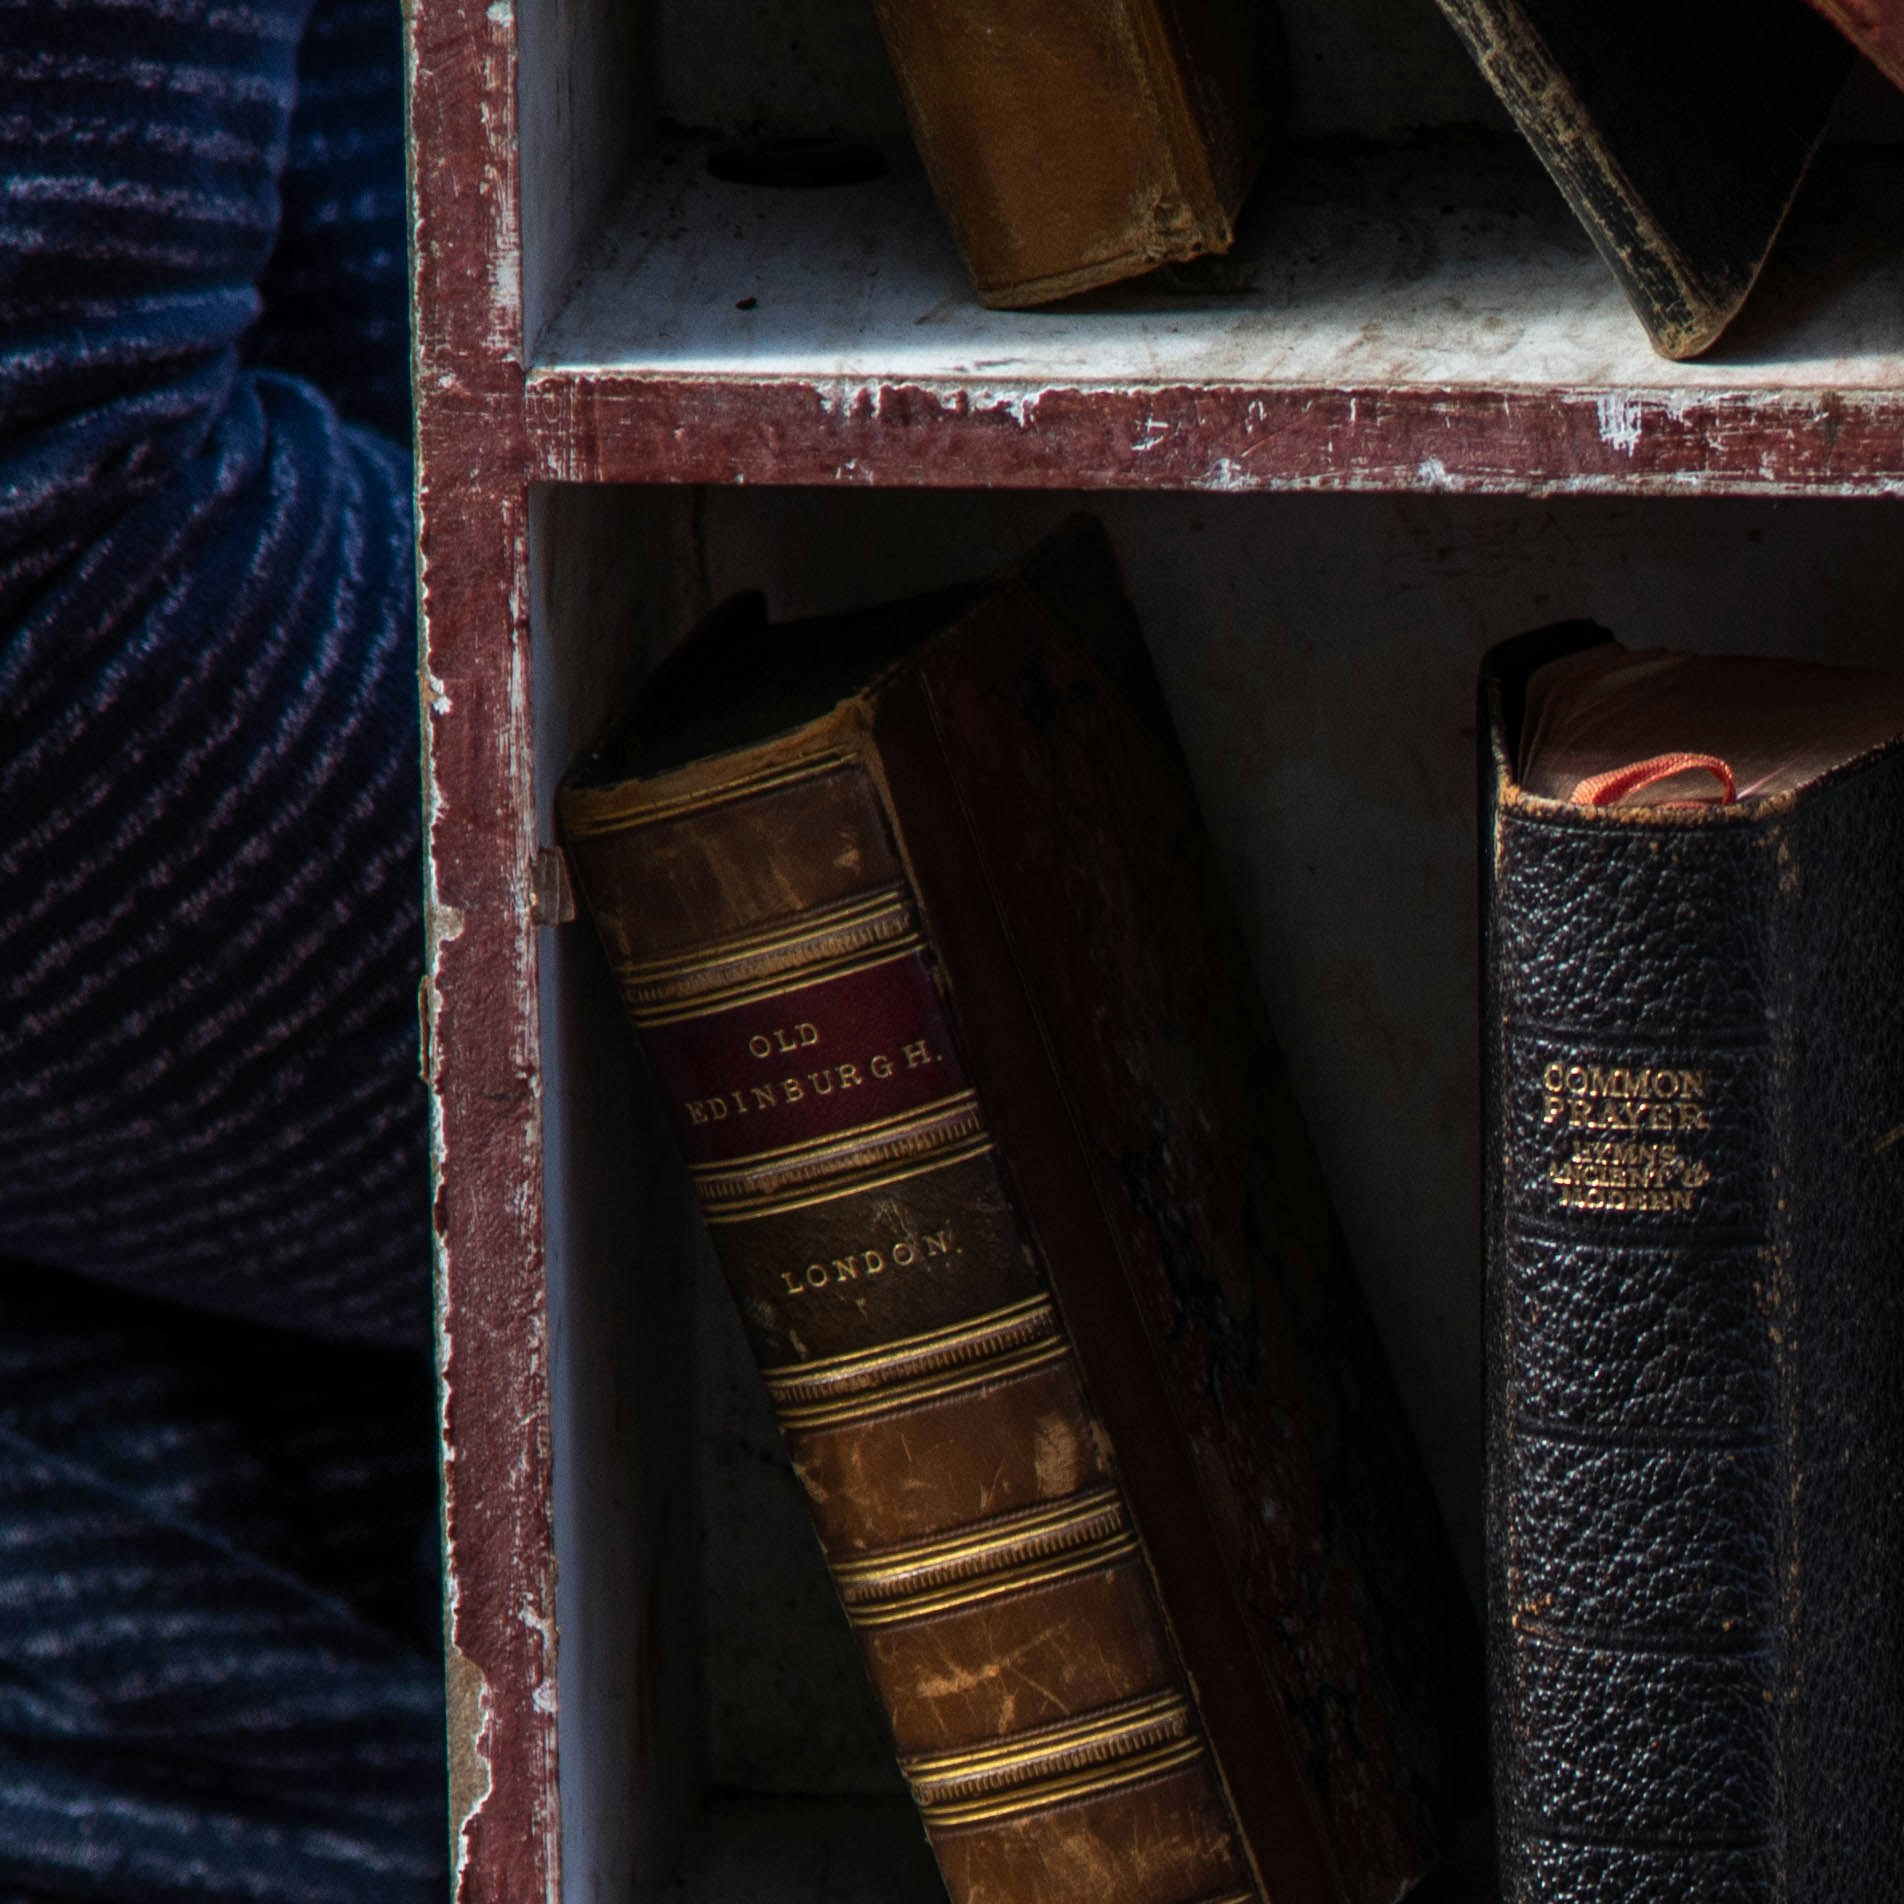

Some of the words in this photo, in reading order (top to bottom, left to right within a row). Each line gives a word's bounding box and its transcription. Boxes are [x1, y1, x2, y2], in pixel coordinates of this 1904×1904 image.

[747, 1021, 820, 1063] OLD
[684, 1038, 944, 1125] EDINBURGH.
[1543, 1061, 1708, 1099] COMMON
[1543, 1096, 1711, 1131] PRAYER
[1548, 1160, 1674, 1188] ANCIENT
[1681, 1162, 1711, 1189] &
[1558, 1189, 1697, 1212] MODERN
[780, 1230, 964, 1295] LONDON.
